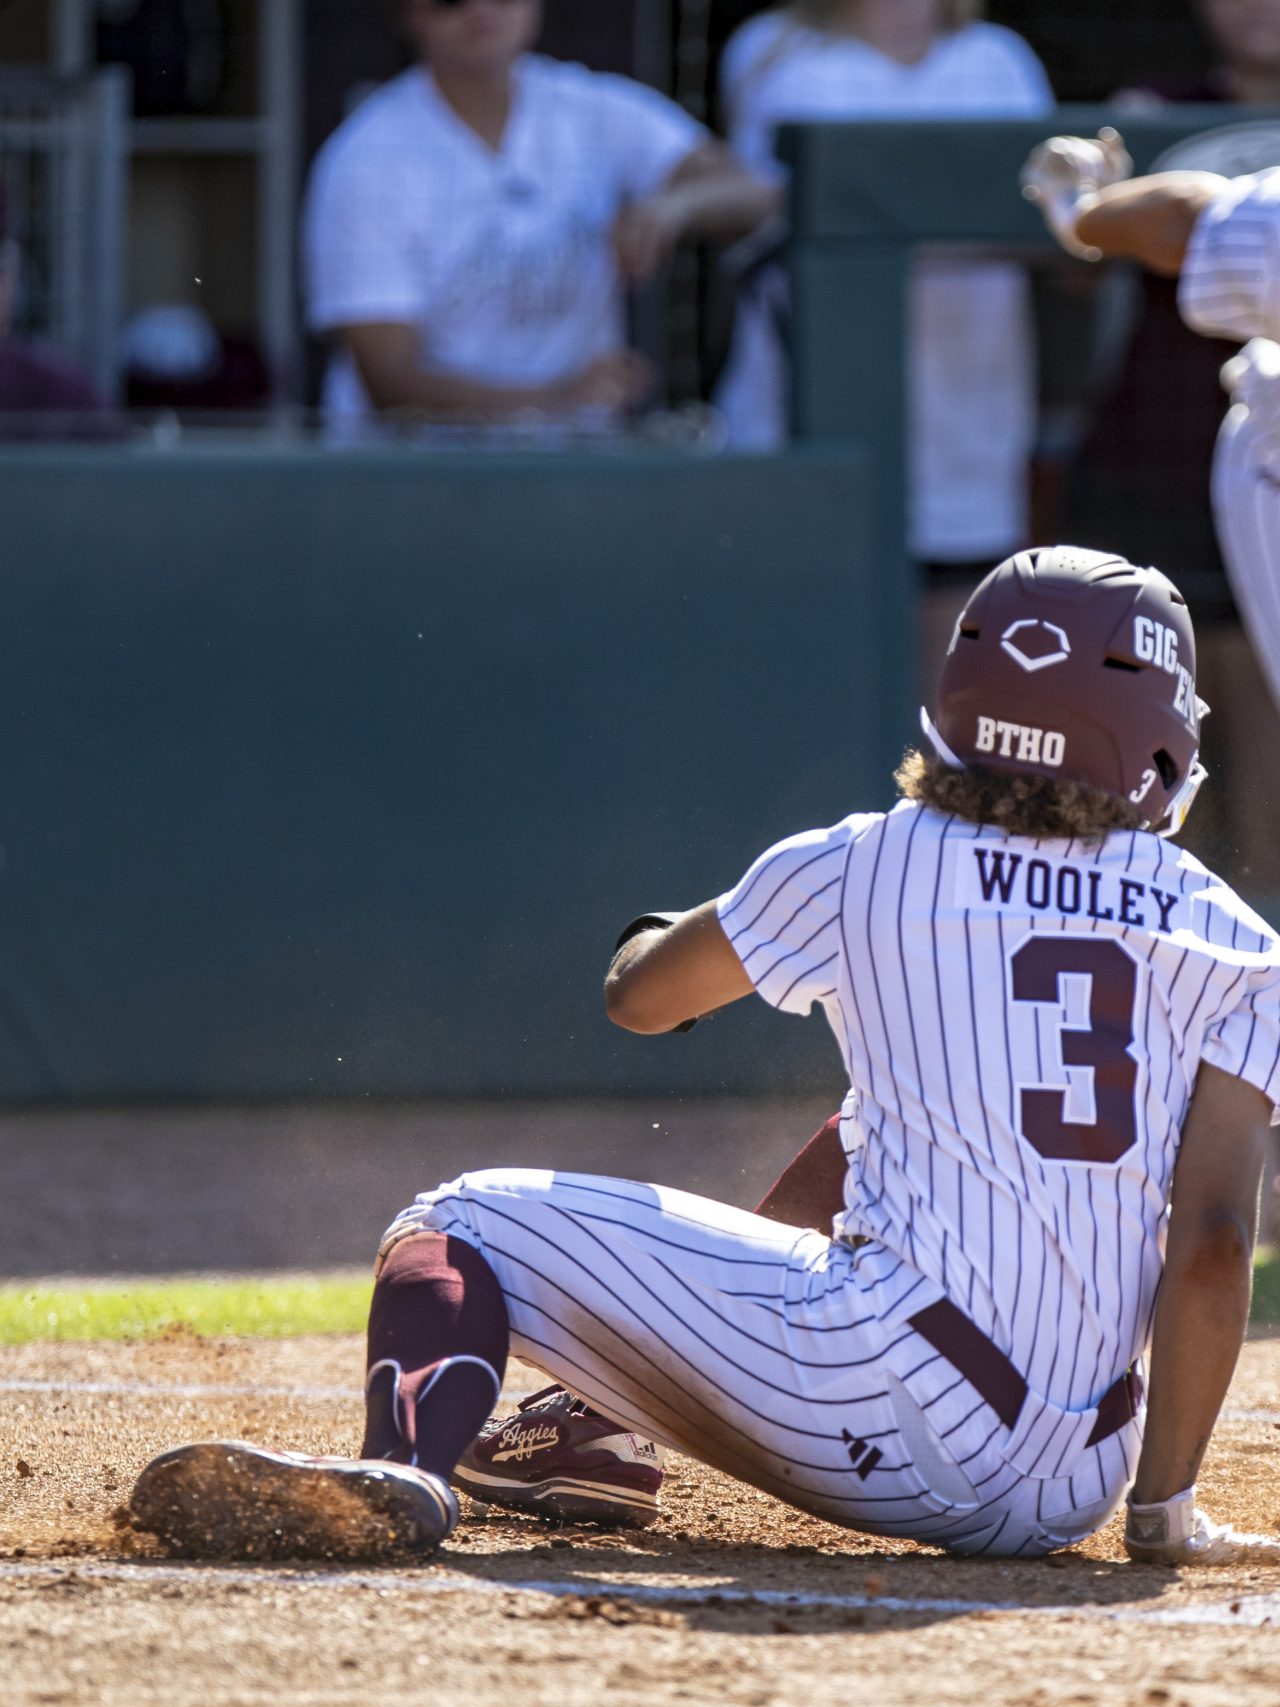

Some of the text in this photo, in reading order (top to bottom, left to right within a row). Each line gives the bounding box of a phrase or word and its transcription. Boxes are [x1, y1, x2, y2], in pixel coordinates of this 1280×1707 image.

[1134, 615, 1178, 674] GIG
[976, 715, 1066, 768] BTHO
[1129, 768, 1156, 804] 3
[974, 847, 1179, 934] WOOLEY
[1008, 931, 1144, 1165] 3
[496, 1422, 559, 1462] Aggies
